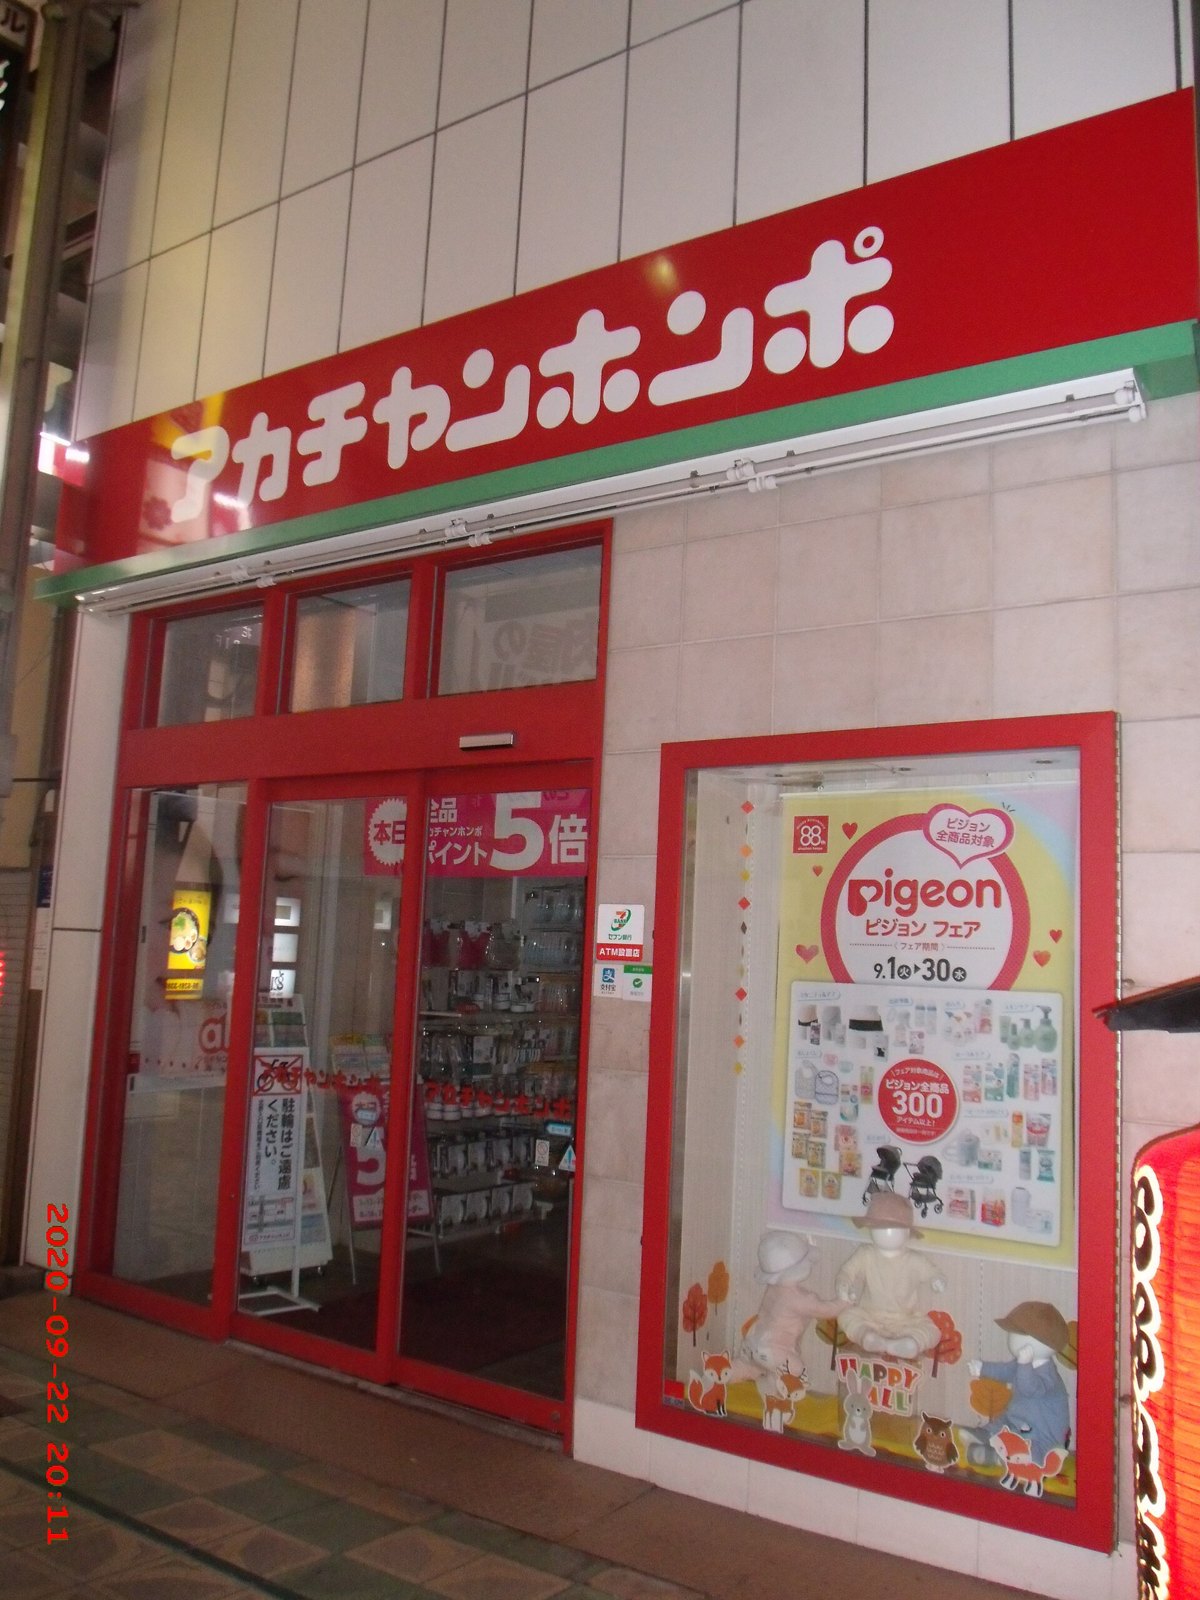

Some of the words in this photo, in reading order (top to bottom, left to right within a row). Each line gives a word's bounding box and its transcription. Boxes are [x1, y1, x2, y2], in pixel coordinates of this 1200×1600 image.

[171, 226, 895, 524] アカチャンホンポ
[946, 816, 991, 833] ピジョン
[936, 829, 995, 849] 全商品対象
[865, 918, 928, 938] ピジョン
[933, 920, 982, 940] フェア
[885, 1079, 950, 1095] ピジョン全商品
[891, 1090, 944, 1119] 300
